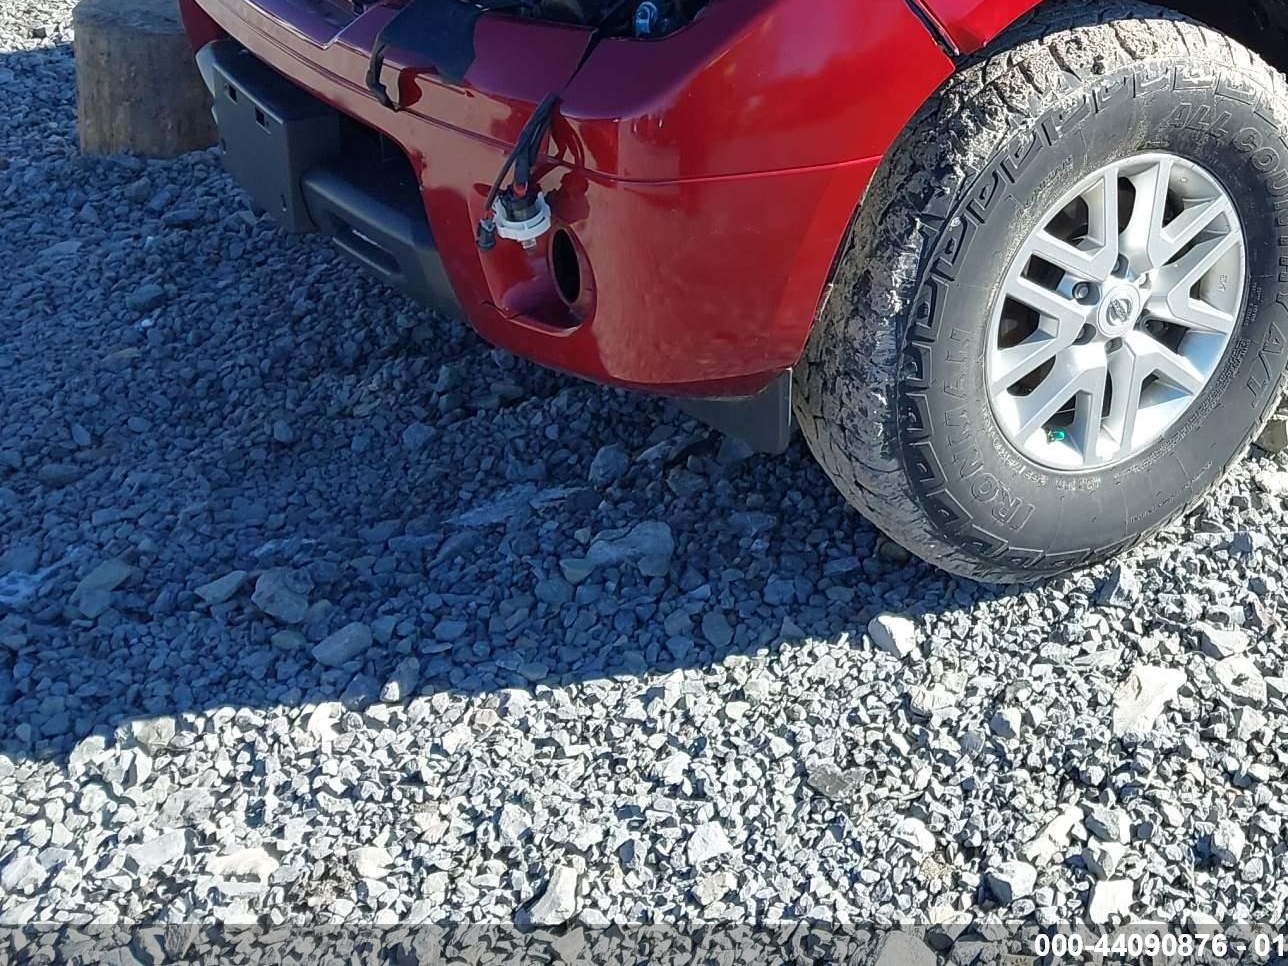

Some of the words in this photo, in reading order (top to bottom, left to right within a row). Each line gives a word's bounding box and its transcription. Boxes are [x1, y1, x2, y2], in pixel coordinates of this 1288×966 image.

[1160, 102, 1232, 139] ALL
[1246, 321, 1288, 409] A/T
[943, 326, 1036, 532] IRONMAN
